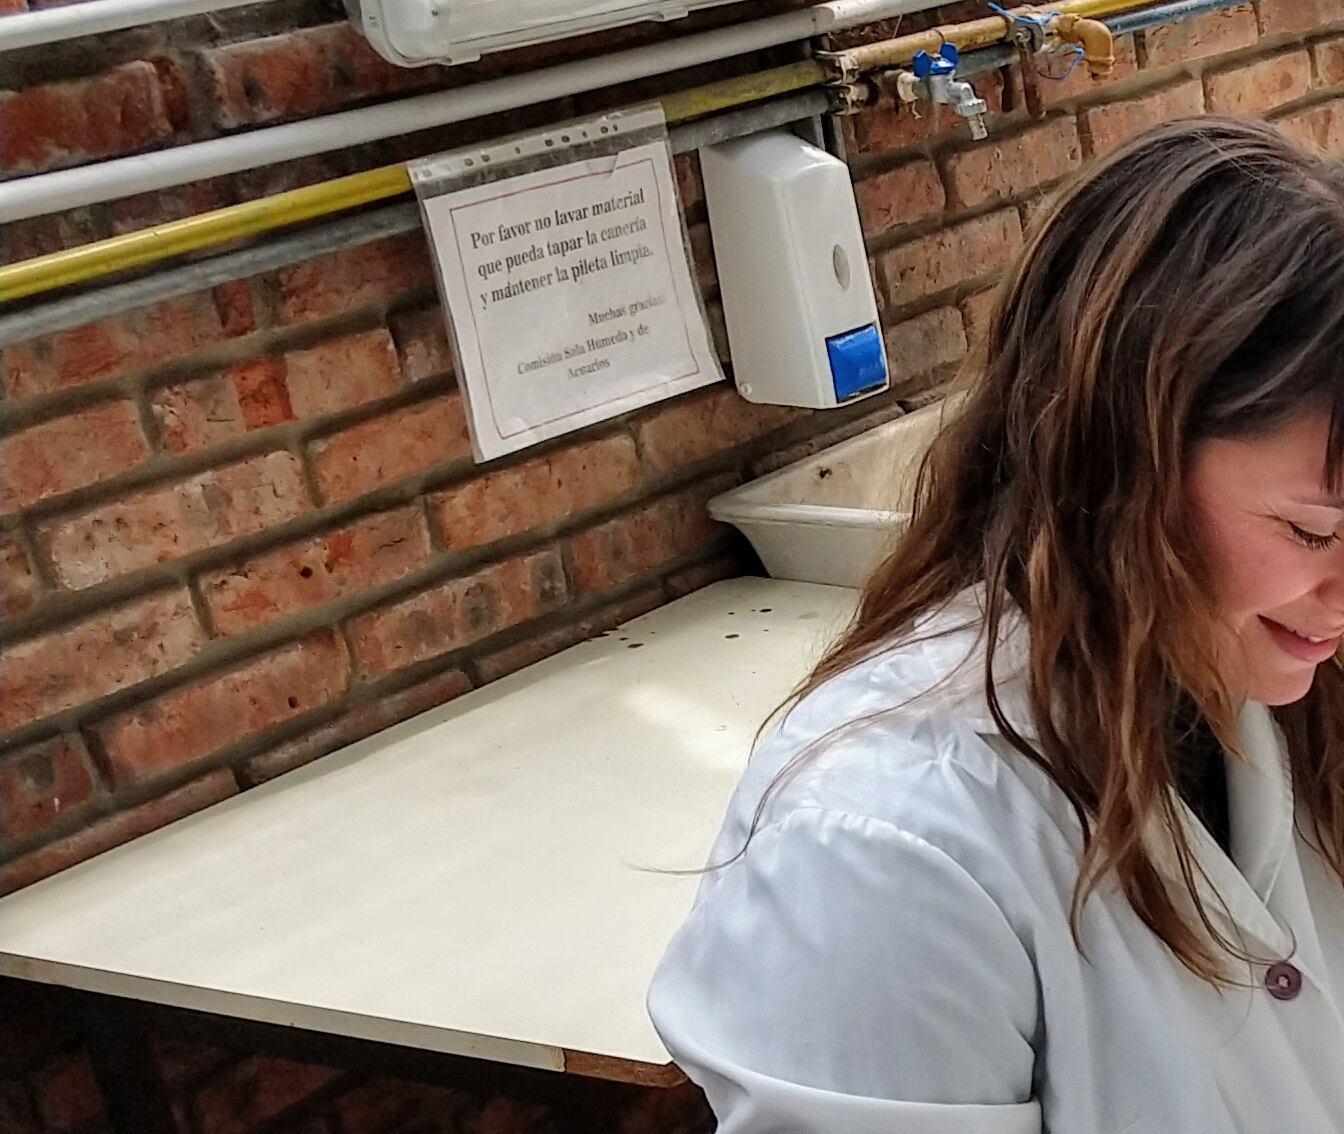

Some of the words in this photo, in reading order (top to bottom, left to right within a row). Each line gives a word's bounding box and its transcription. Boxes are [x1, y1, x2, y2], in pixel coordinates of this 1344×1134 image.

[470, 232, 496, 249] Por
[499, 220, 531, 242] favor
[536, 217, 551, 231] no
[554, 205, 589, 226] lavar
[592, 188, 645, 217] material
[478, 259, 502, 280] que
[506, 245, 544, 273] pueda
[547, 236, 584, 258] tapar
[586, 230, 599, 245] la
[480, 293, 488, 310] y
[556, 267, 569, 282] la
[572, 257, 608, 283] pileta
[611, 244, 653, 267] limpia.
[588, 304, 627, 327] Muchas
[564, 342, 586, 359] Sala
[637, 323, 649, 336] de
[567, 358, 611, 380] Acuarios
